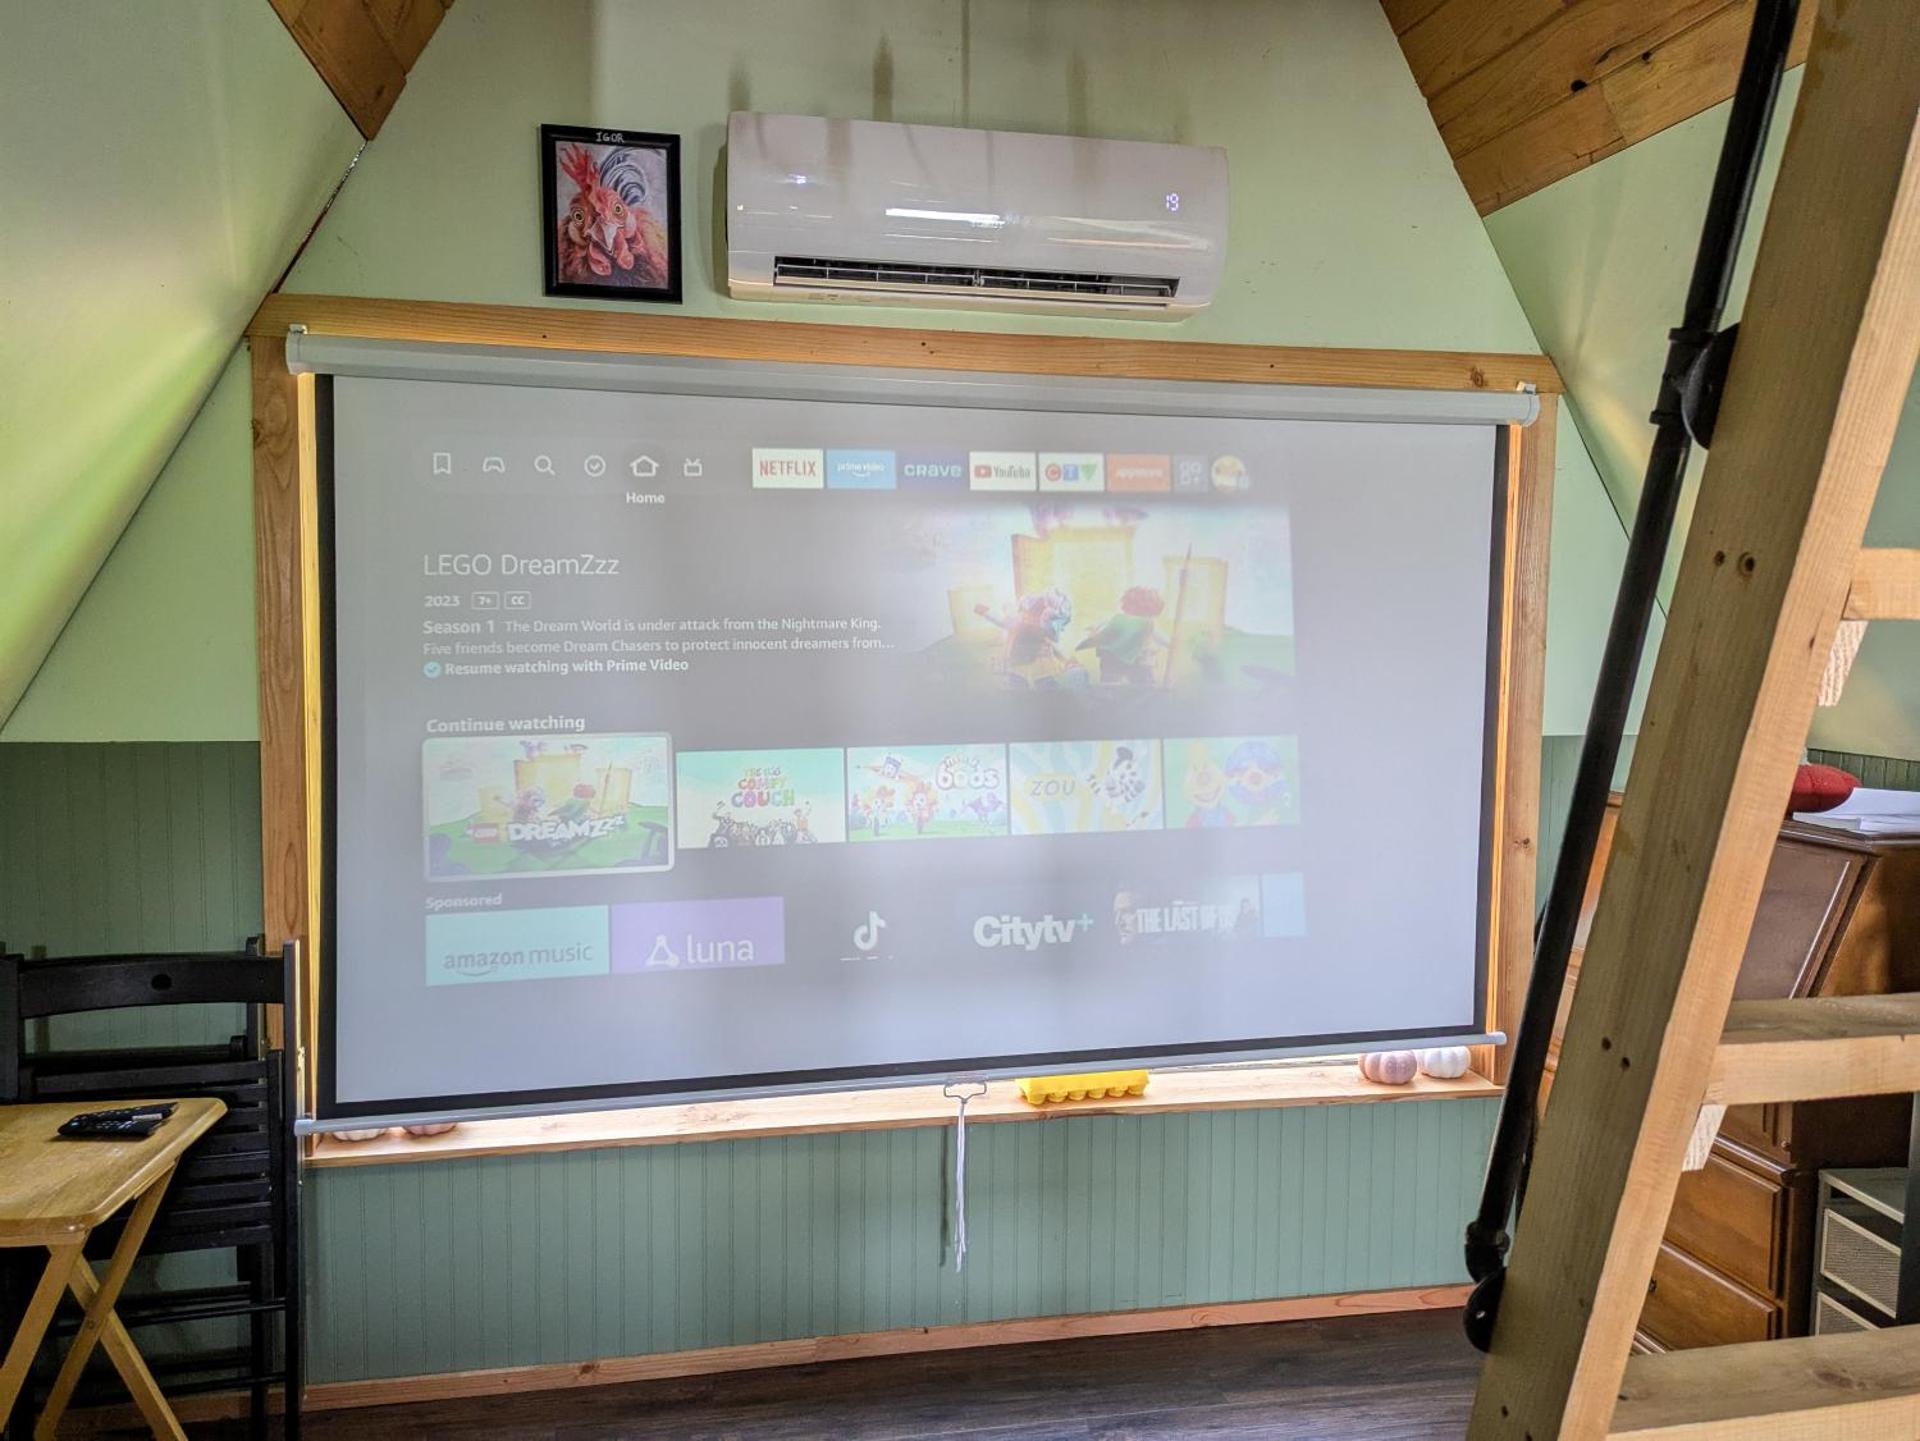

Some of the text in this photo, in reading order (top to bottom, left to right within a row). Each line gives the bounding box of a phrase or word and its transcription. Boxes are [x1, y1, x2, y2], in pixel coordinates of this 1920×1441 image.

[596, 131, 625, 144] IGOR
[1166, 193, 1179, 211] 19
[759, 460, 817, 477] NETFLIX
[626, 491, 666, 504] Home
[423, 553, 620, 576] LEGO DreamZzz
[424, 595, 461, 608] 2023
[423, 617, 882, 635] Season 1 The Dream World is under attack from the Nightmare King.
[423, 643, 455, 656] Five
[455, 641, 503, 655] friends
[506, 641, 560, 654] become
[563, 640, 608, 653] Dream
[611, 639, 662, 652] Chasers
[665, 640, 680, 651] to
[682, 640, 730, 653] protect
[732, 639, 788, 650] innocent
[791, 638, 850, 650] dreamers
[445, 658, 689, 676] Resume watching with Prime Video
[426, 716, 586, 733] Continue watching
[1031, 780, 1076, 797] ZOU
[731, 789, 795, 808] COUCH
[425, 893, 503, 911] Sponsored
[1136, 907, 1162, 934] THE
[1163, 905, 1200, 932] LAST
[443, 942, 593, 971] amazon music
[686, 934, 755, 964] luna
